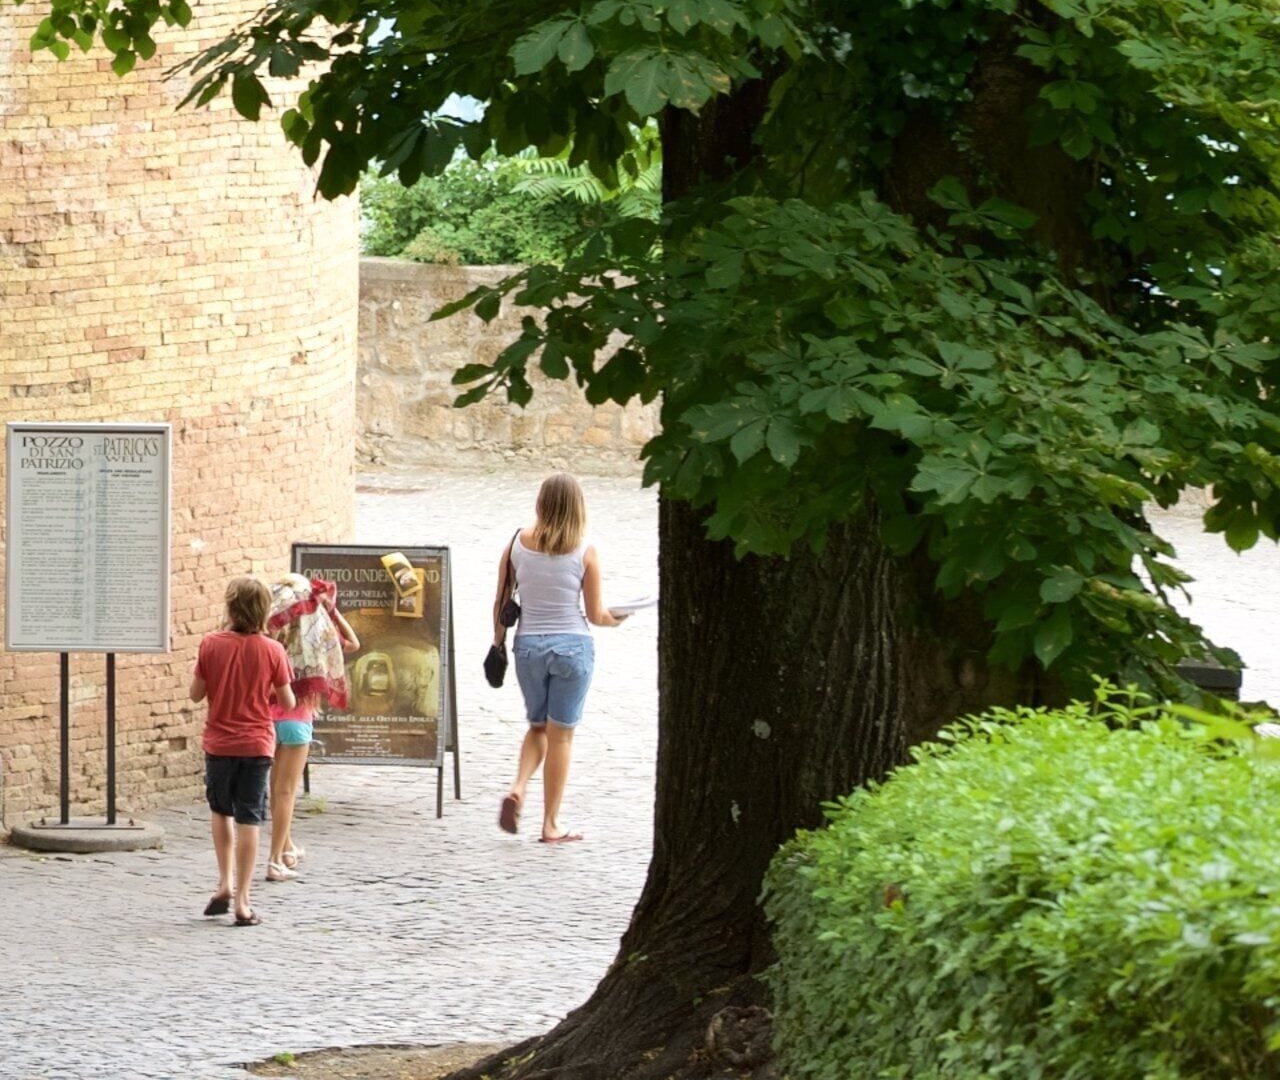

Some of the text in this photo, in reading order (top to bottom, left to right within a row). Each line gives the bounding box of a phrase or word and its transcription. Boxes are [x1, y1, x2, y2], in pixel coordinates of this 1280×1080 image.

[23, 436, 84, 448] POZZO
[104, 436, 159, 457] PATRICK'S
[29, 447, 74, 458] DI SAN
[21, 458, 84, 470] PATRIZIO
[303, 568, 352, 582] ORVIETO
